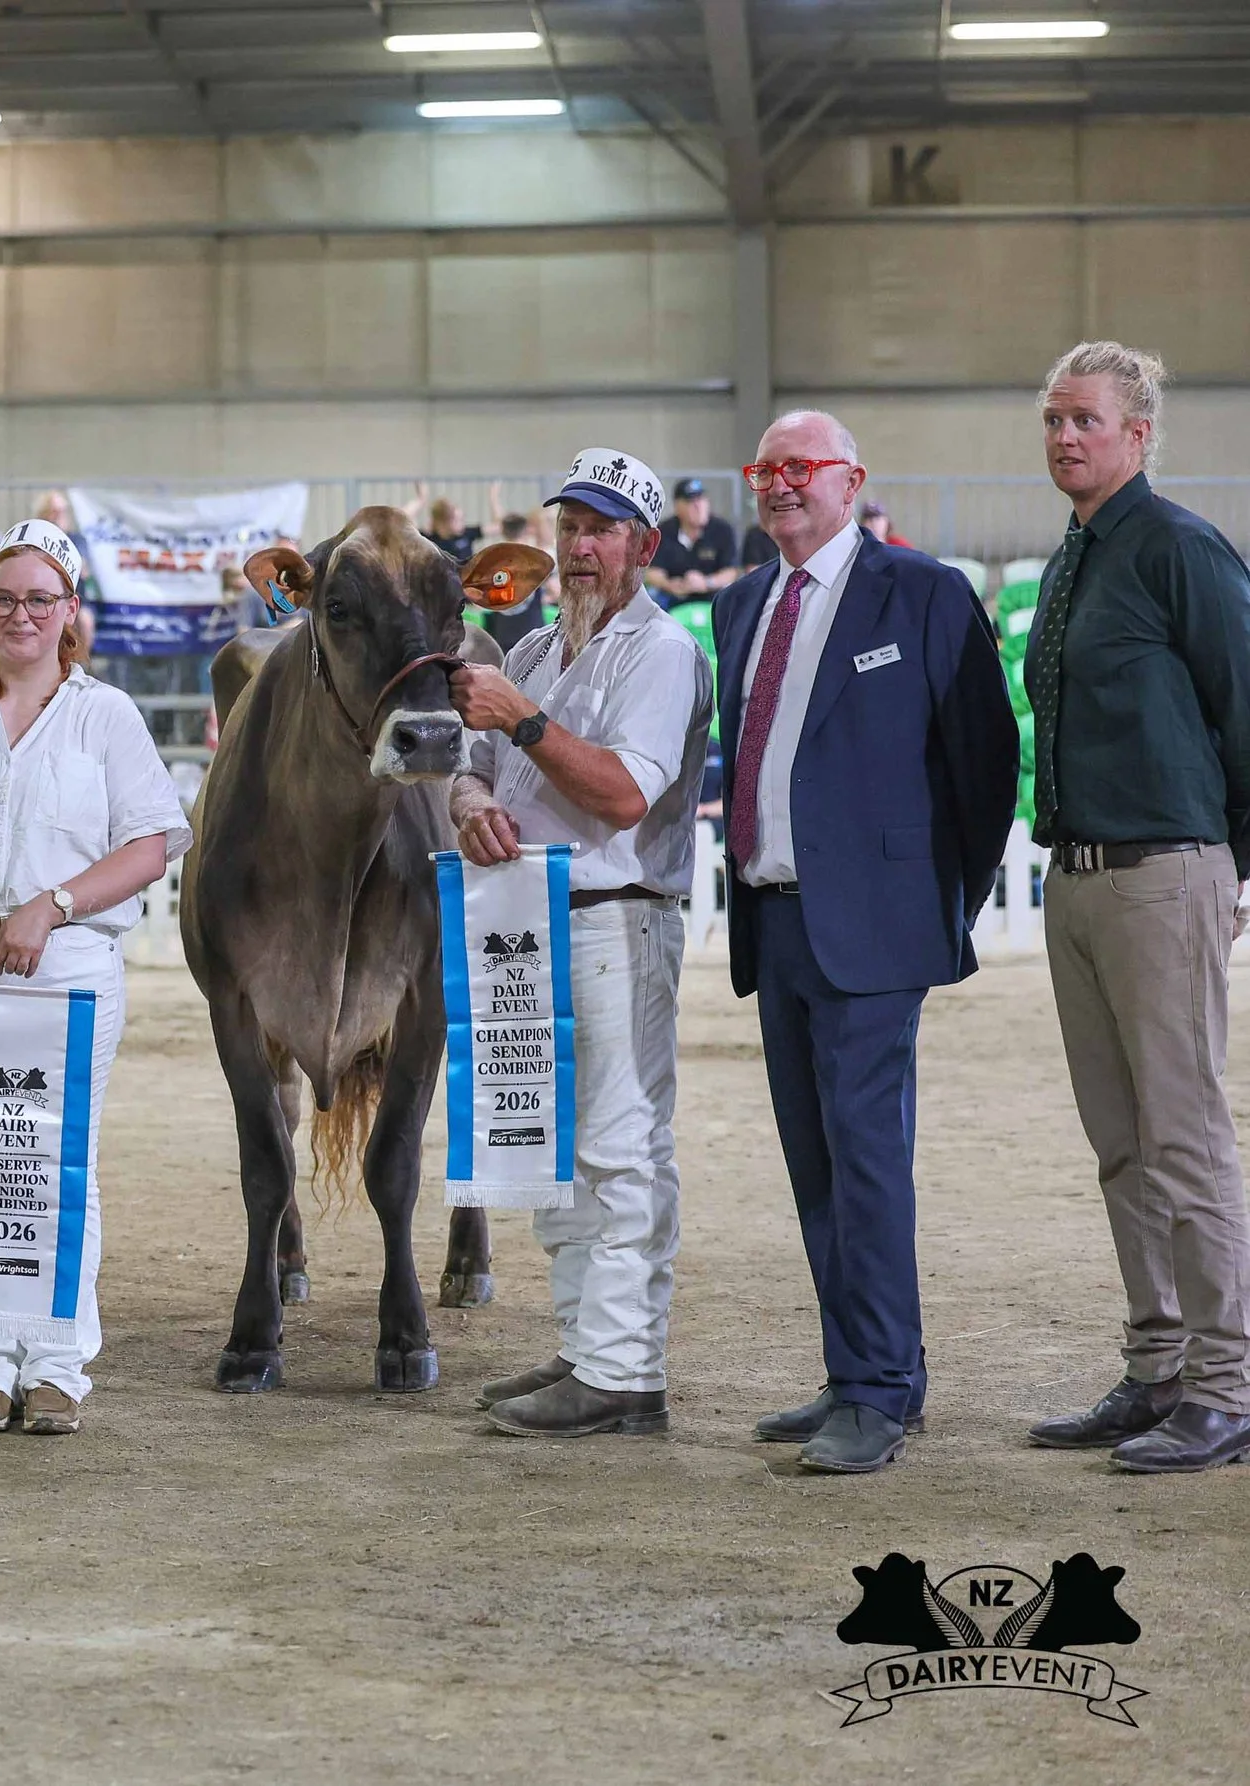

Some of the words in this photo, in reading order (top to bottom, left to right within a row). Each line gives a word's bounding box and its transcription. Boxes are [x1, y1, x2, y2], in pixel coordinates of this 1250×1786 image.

[891, 145, 940, 205] K
[41, 536, 76, 578] SEMEX
[506, 968, 525, 981] NZ
[493, 983, 536, 998] DAIRY
[492, 999, 539, 1013] EVENT
[476, 1027, 552, 1042] CHAMPION
[491, 1045, 543, 1059] SENIOR
[478, 1060, 553, 1075] COMBINED
[11, 1072, 21, 1080] NZ
[494, 1090, 541, 1111] 2026
[2, 1103, 25, 1117] NZ
[490, 1136, 507, 1144] PGG
[509, 1135, 544, 1145] Wrightson
